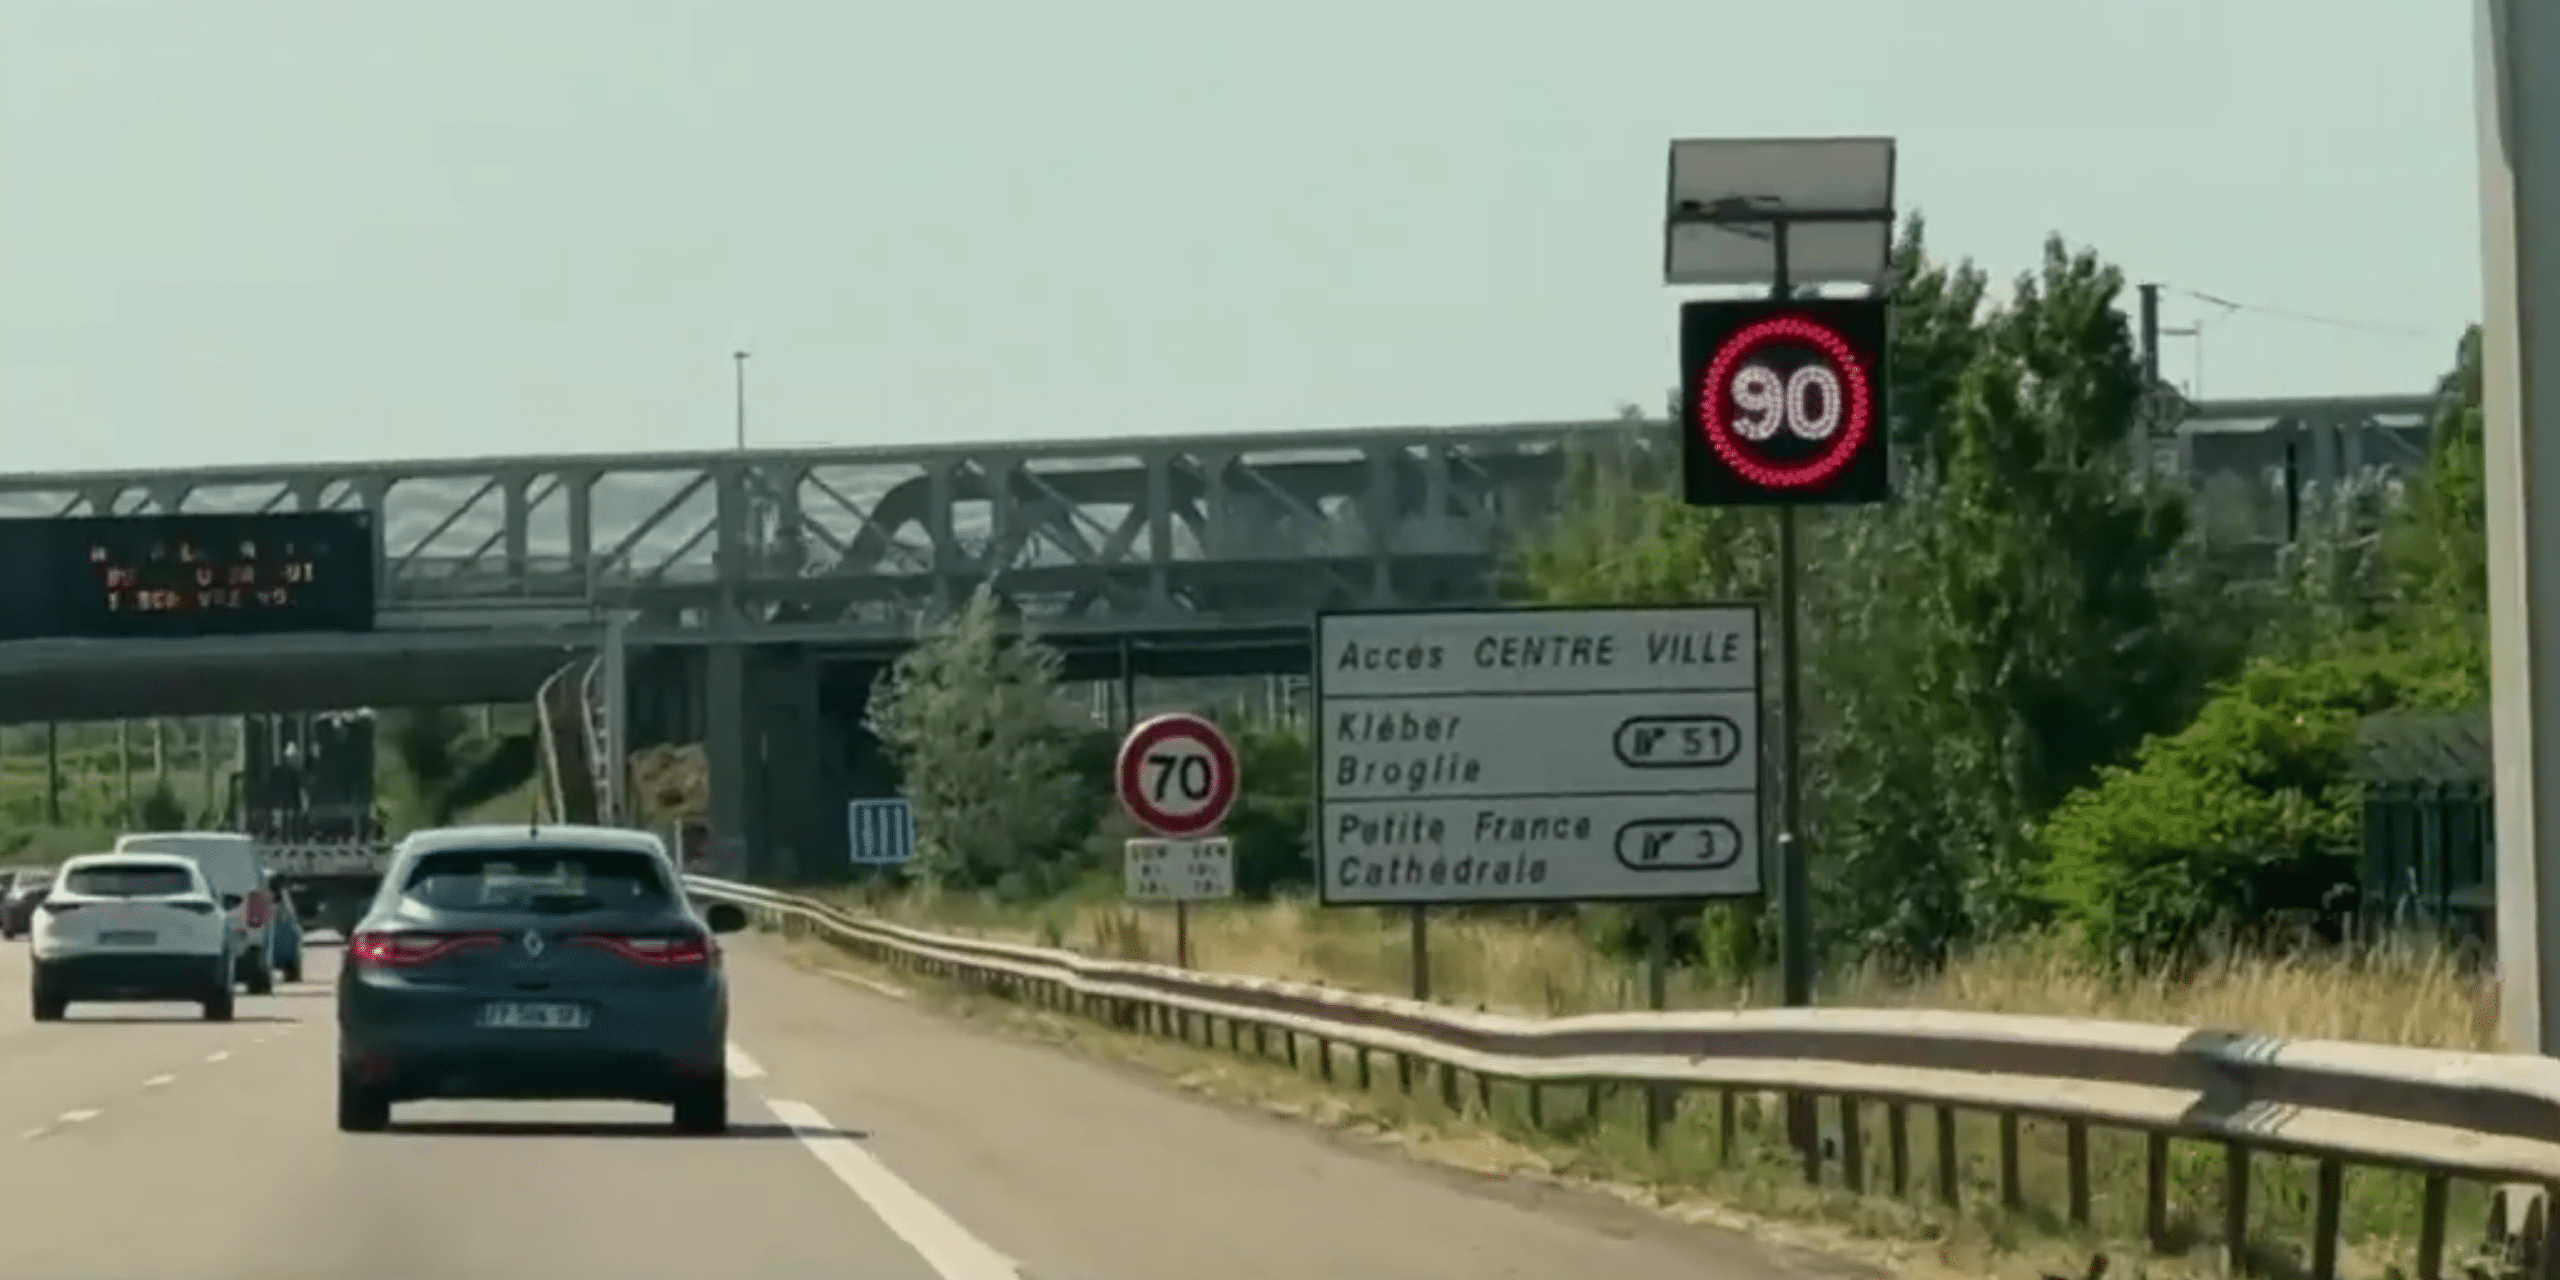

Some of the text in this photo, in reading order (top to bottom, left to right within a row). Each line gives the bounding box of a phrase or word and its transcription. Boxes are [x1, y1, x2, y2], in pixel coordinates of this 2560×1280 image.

[1731, 365, 1841, 441] 90
[1474, 635, 1615, 668] CENTRE
[1648, 632, 1740, 664] VILLE
[1337, 711, 1461, 743] Kléber
[1682, 727, 1723, 757] 51
[1148, 753, 1214, 802] 70
[1337, 755, 1481, 791] Broglie
[1338, 811, 1591, 845] Petite France
[1696, 830, 1716, 860] 3
[1338, 852, 1547, 887] Cathédrale
